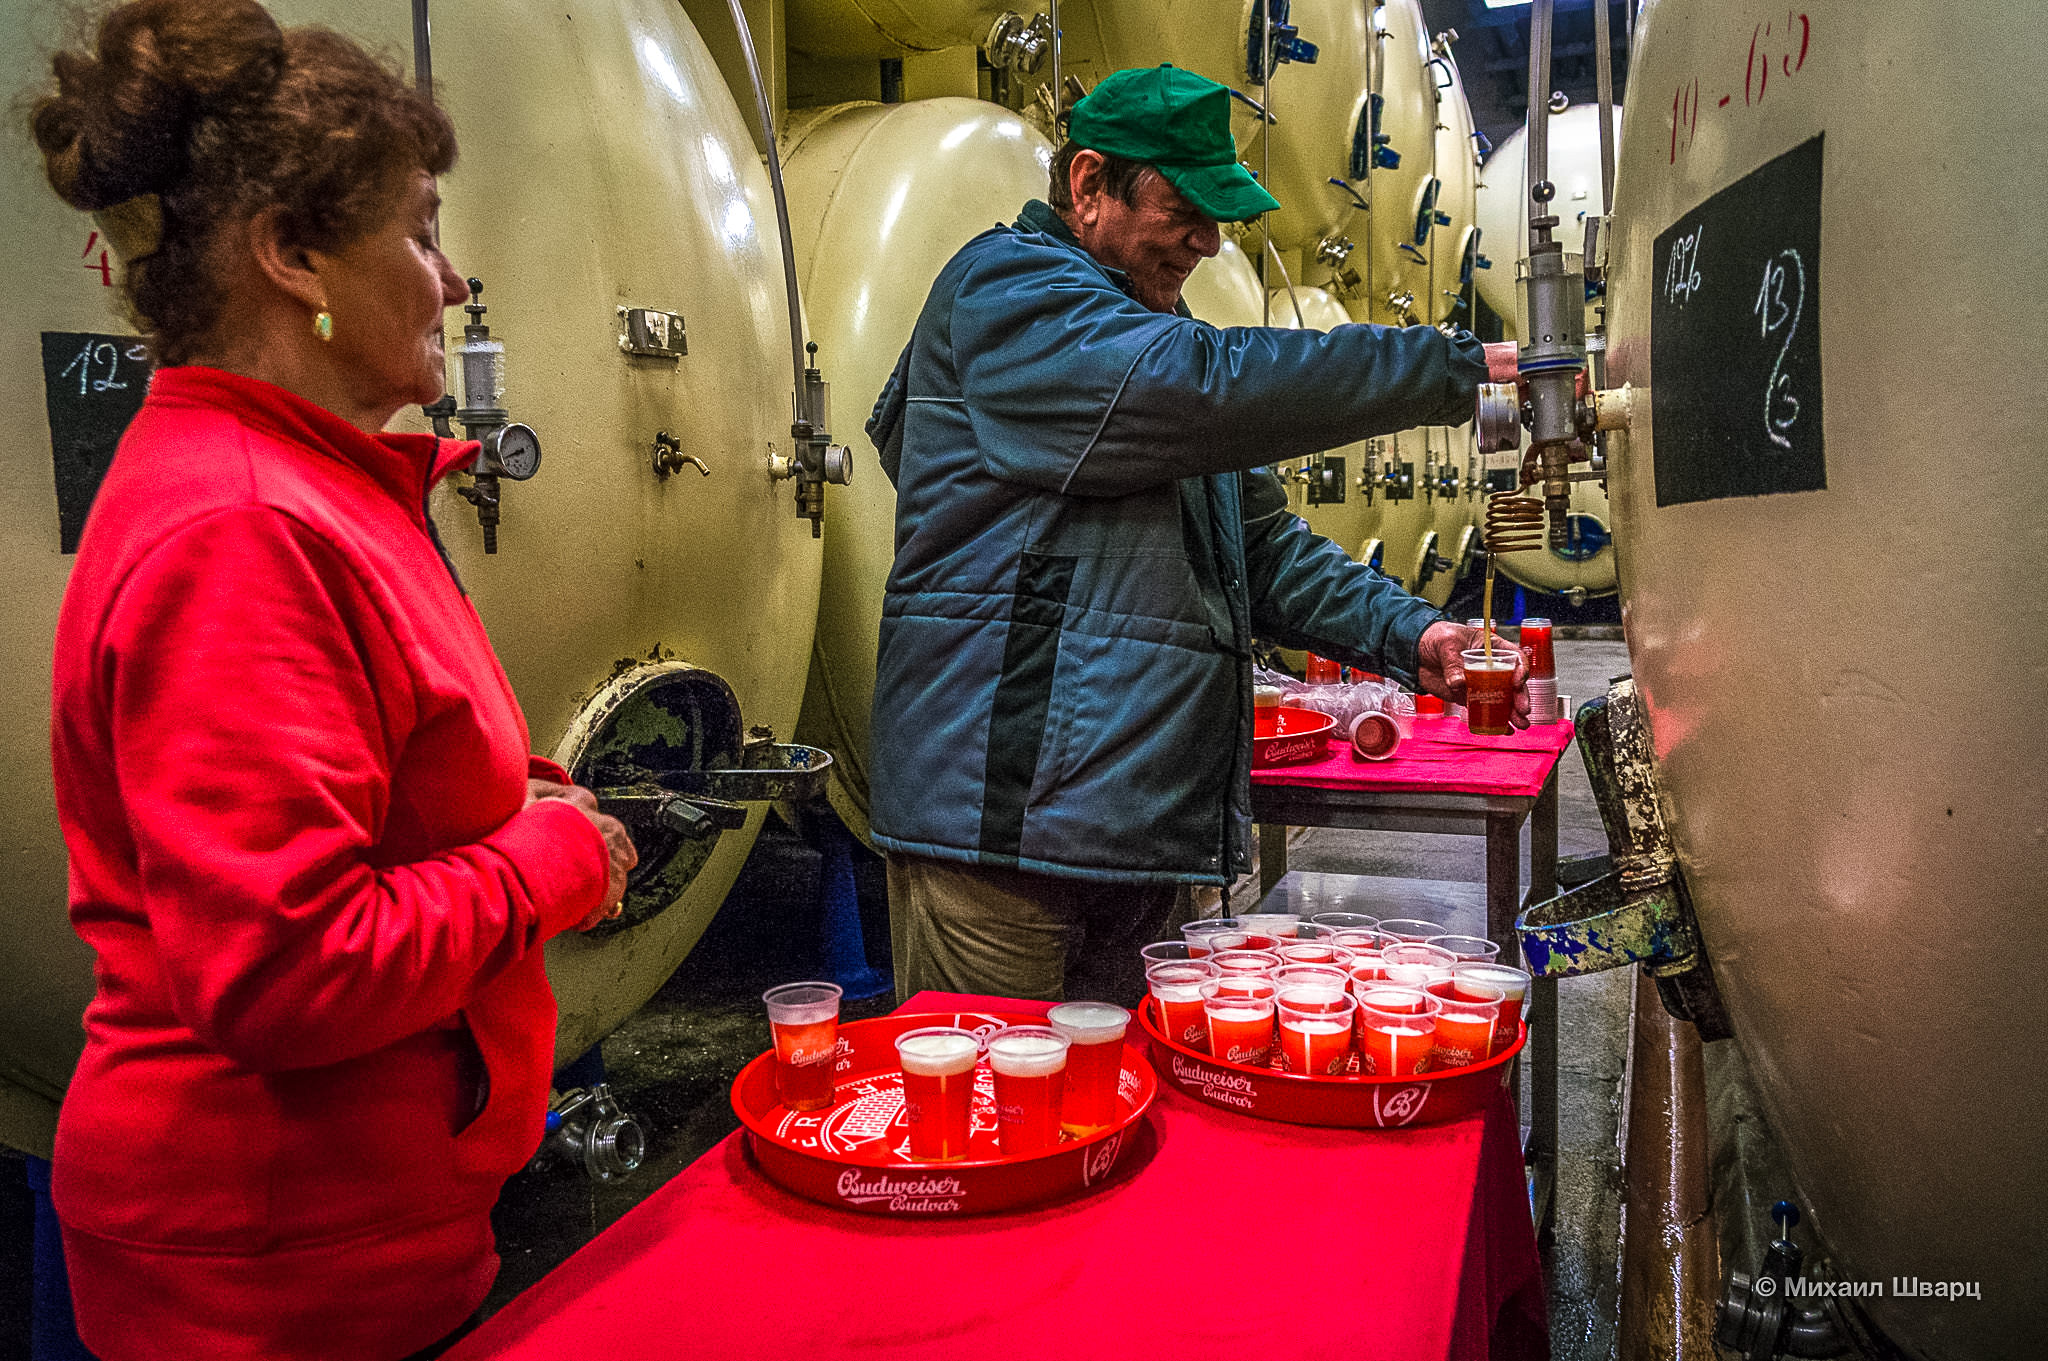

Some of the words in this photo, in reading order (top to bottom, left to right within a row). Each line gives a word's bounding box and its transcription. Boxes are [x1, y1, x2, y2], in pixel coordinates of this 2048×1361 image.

[1172, 1054, 1257, 1096] Budweiser
[1203, 1083, 1255, 1108] Budvar
[837, 1167, 966, 1200] Budweiser
[889, 1194, 961, 1211] Budvar
